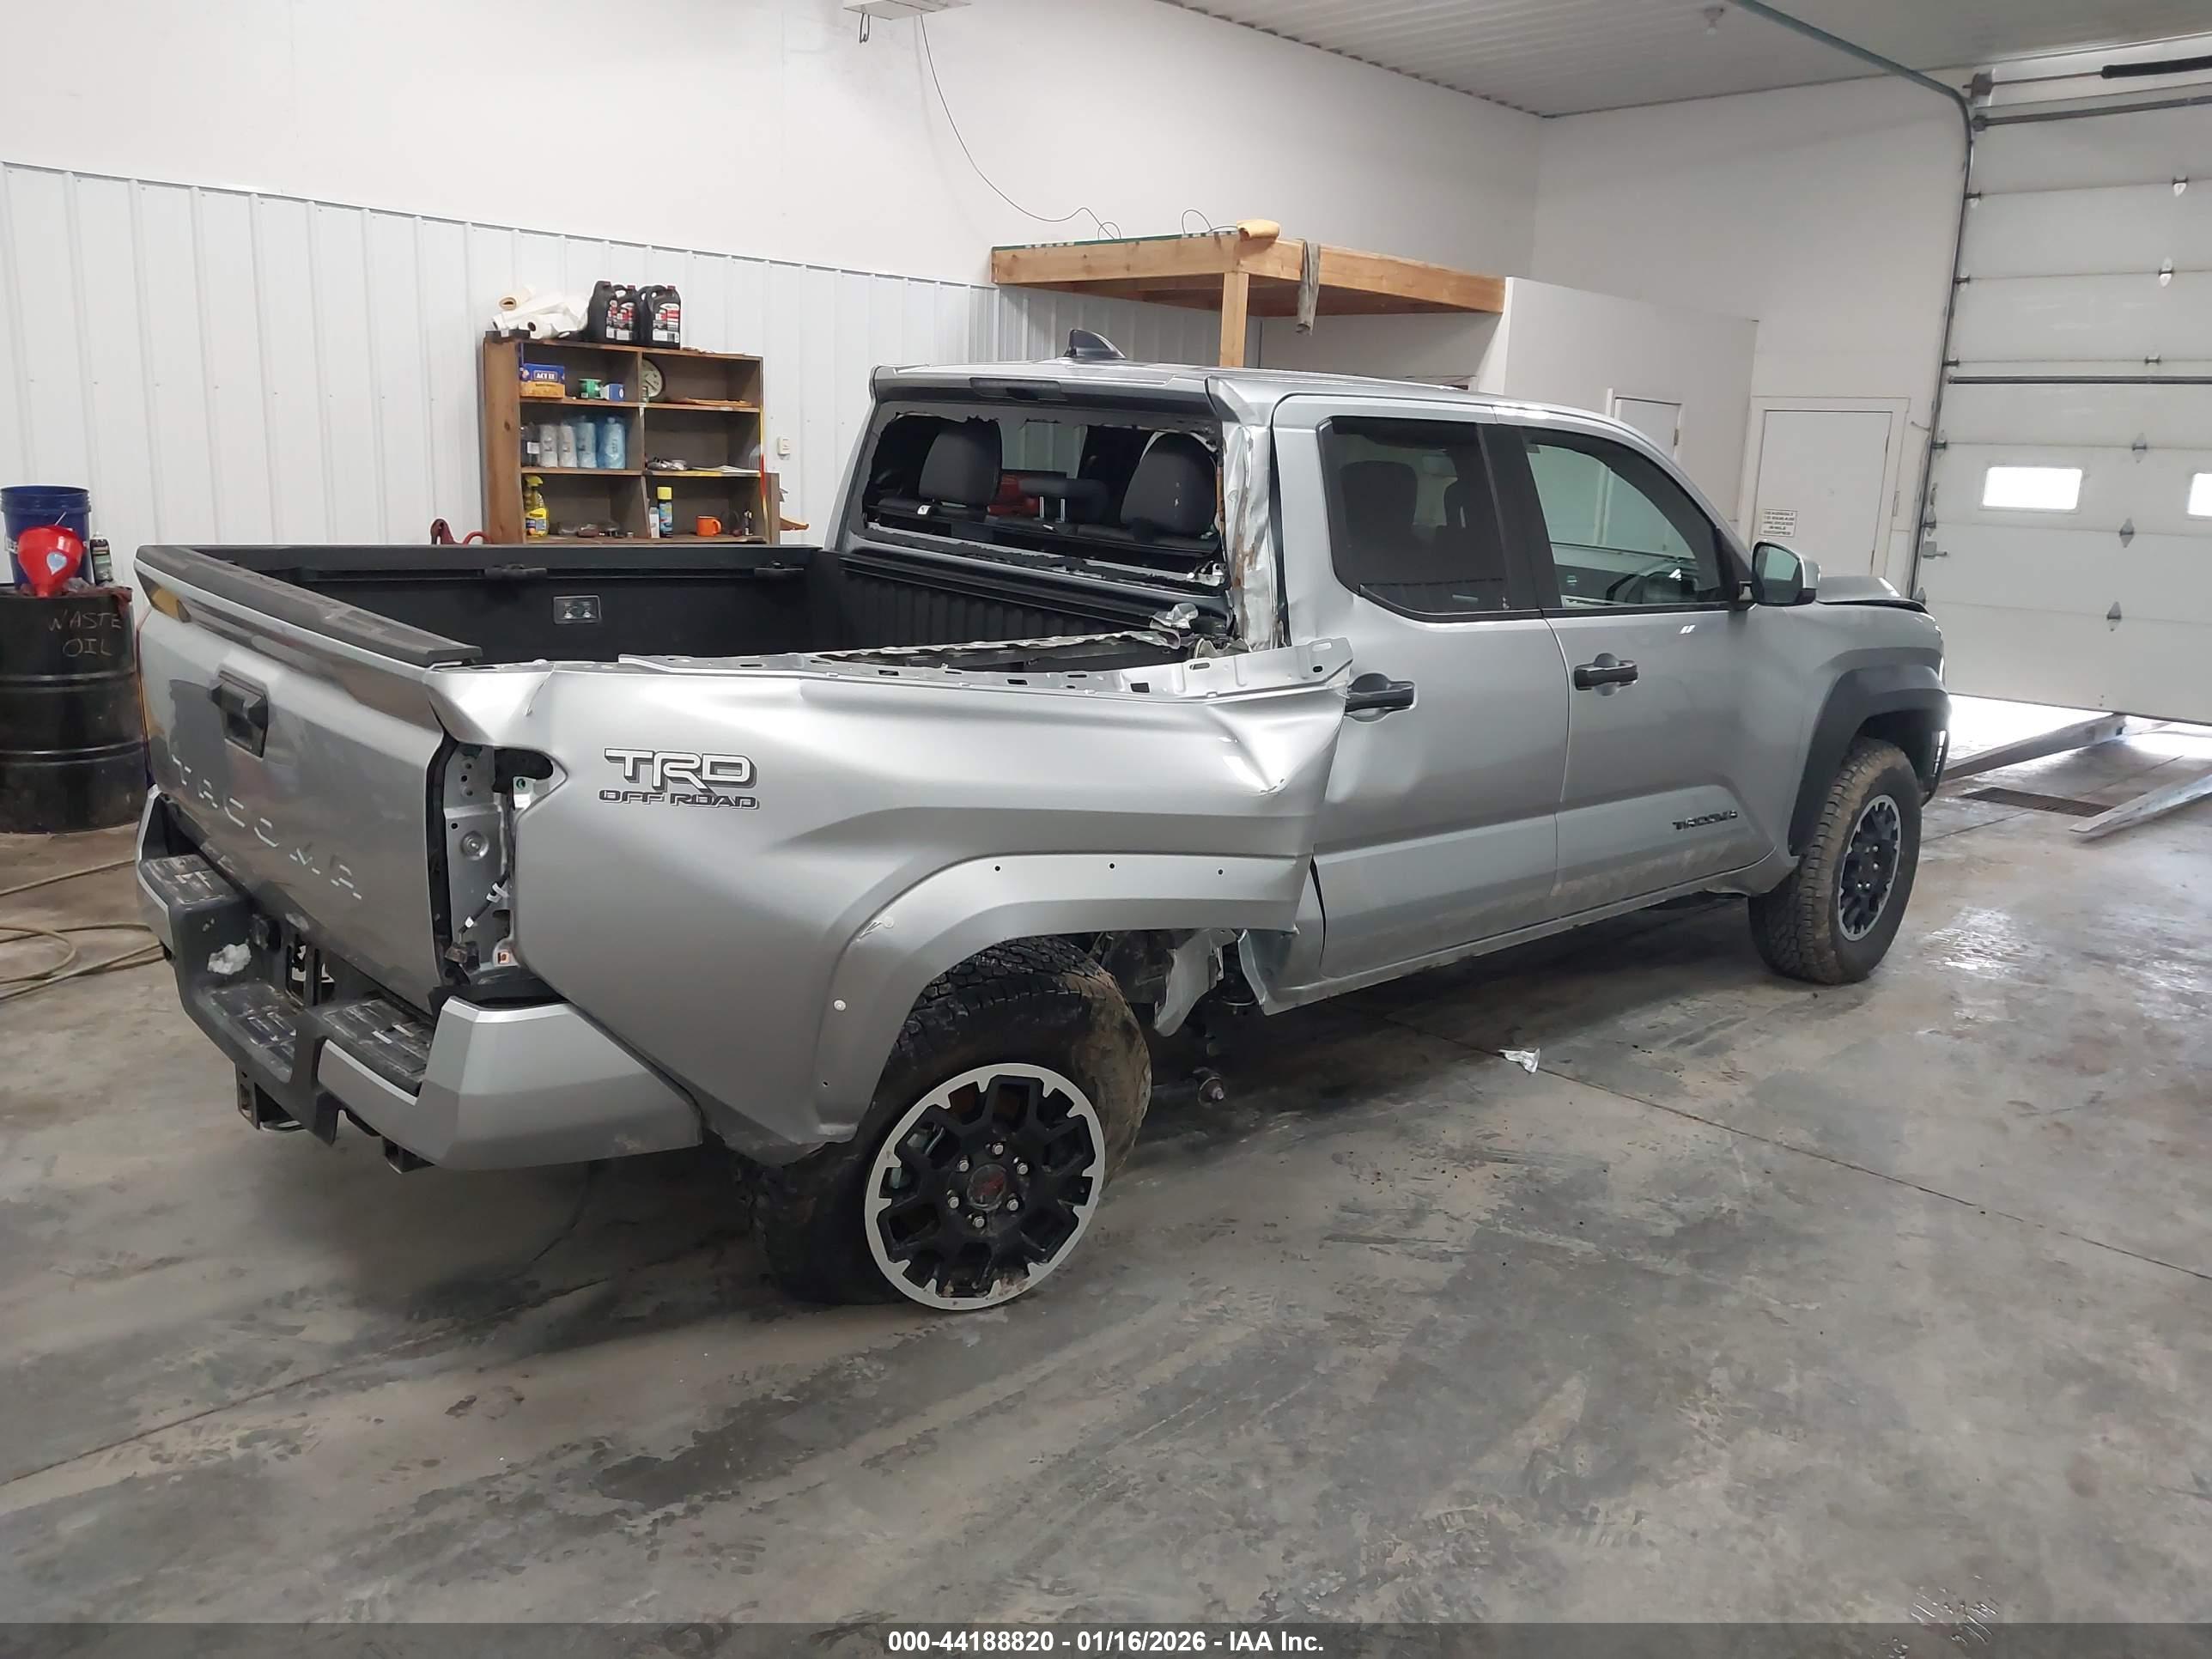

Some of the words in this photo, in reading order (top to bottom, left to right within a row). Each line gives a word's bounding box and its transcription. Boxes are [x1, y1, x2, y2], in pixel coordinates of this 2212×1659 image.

[48, 609, 122, 632] WASTE
[62, 638, 113, 658] OIL
[604, 748, 757, 797] TRD
[599, 789, 665, 805] OFF
[670, 792, 760, 811] ROAD
